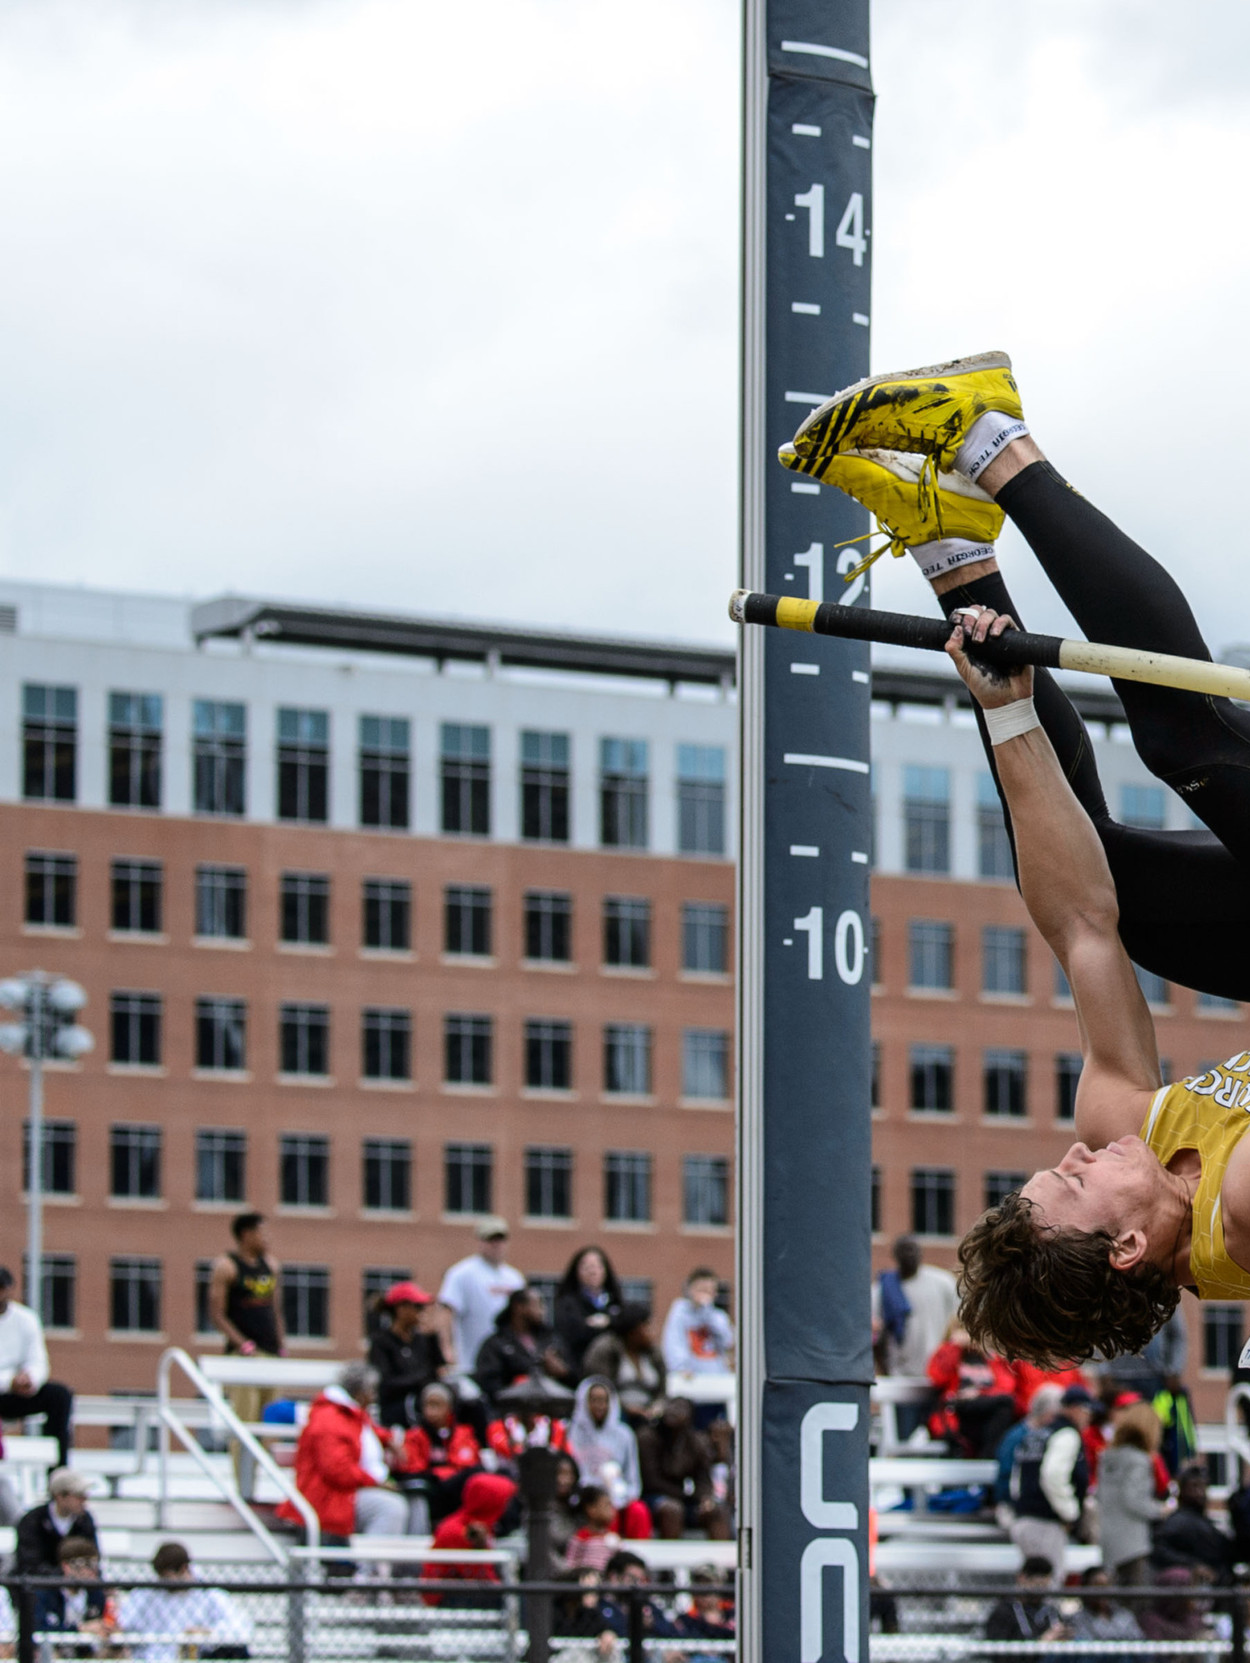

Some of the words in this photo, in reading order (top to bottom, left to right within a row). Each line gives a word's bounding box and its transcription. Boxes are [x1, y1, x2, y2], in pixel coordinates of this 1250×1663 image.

[795, 183, 867, 267] 14
[794, 541, 866, 607] 12
[947, 546, 994, 566] GEORGIA
[794, 906, 865, 985] 10
